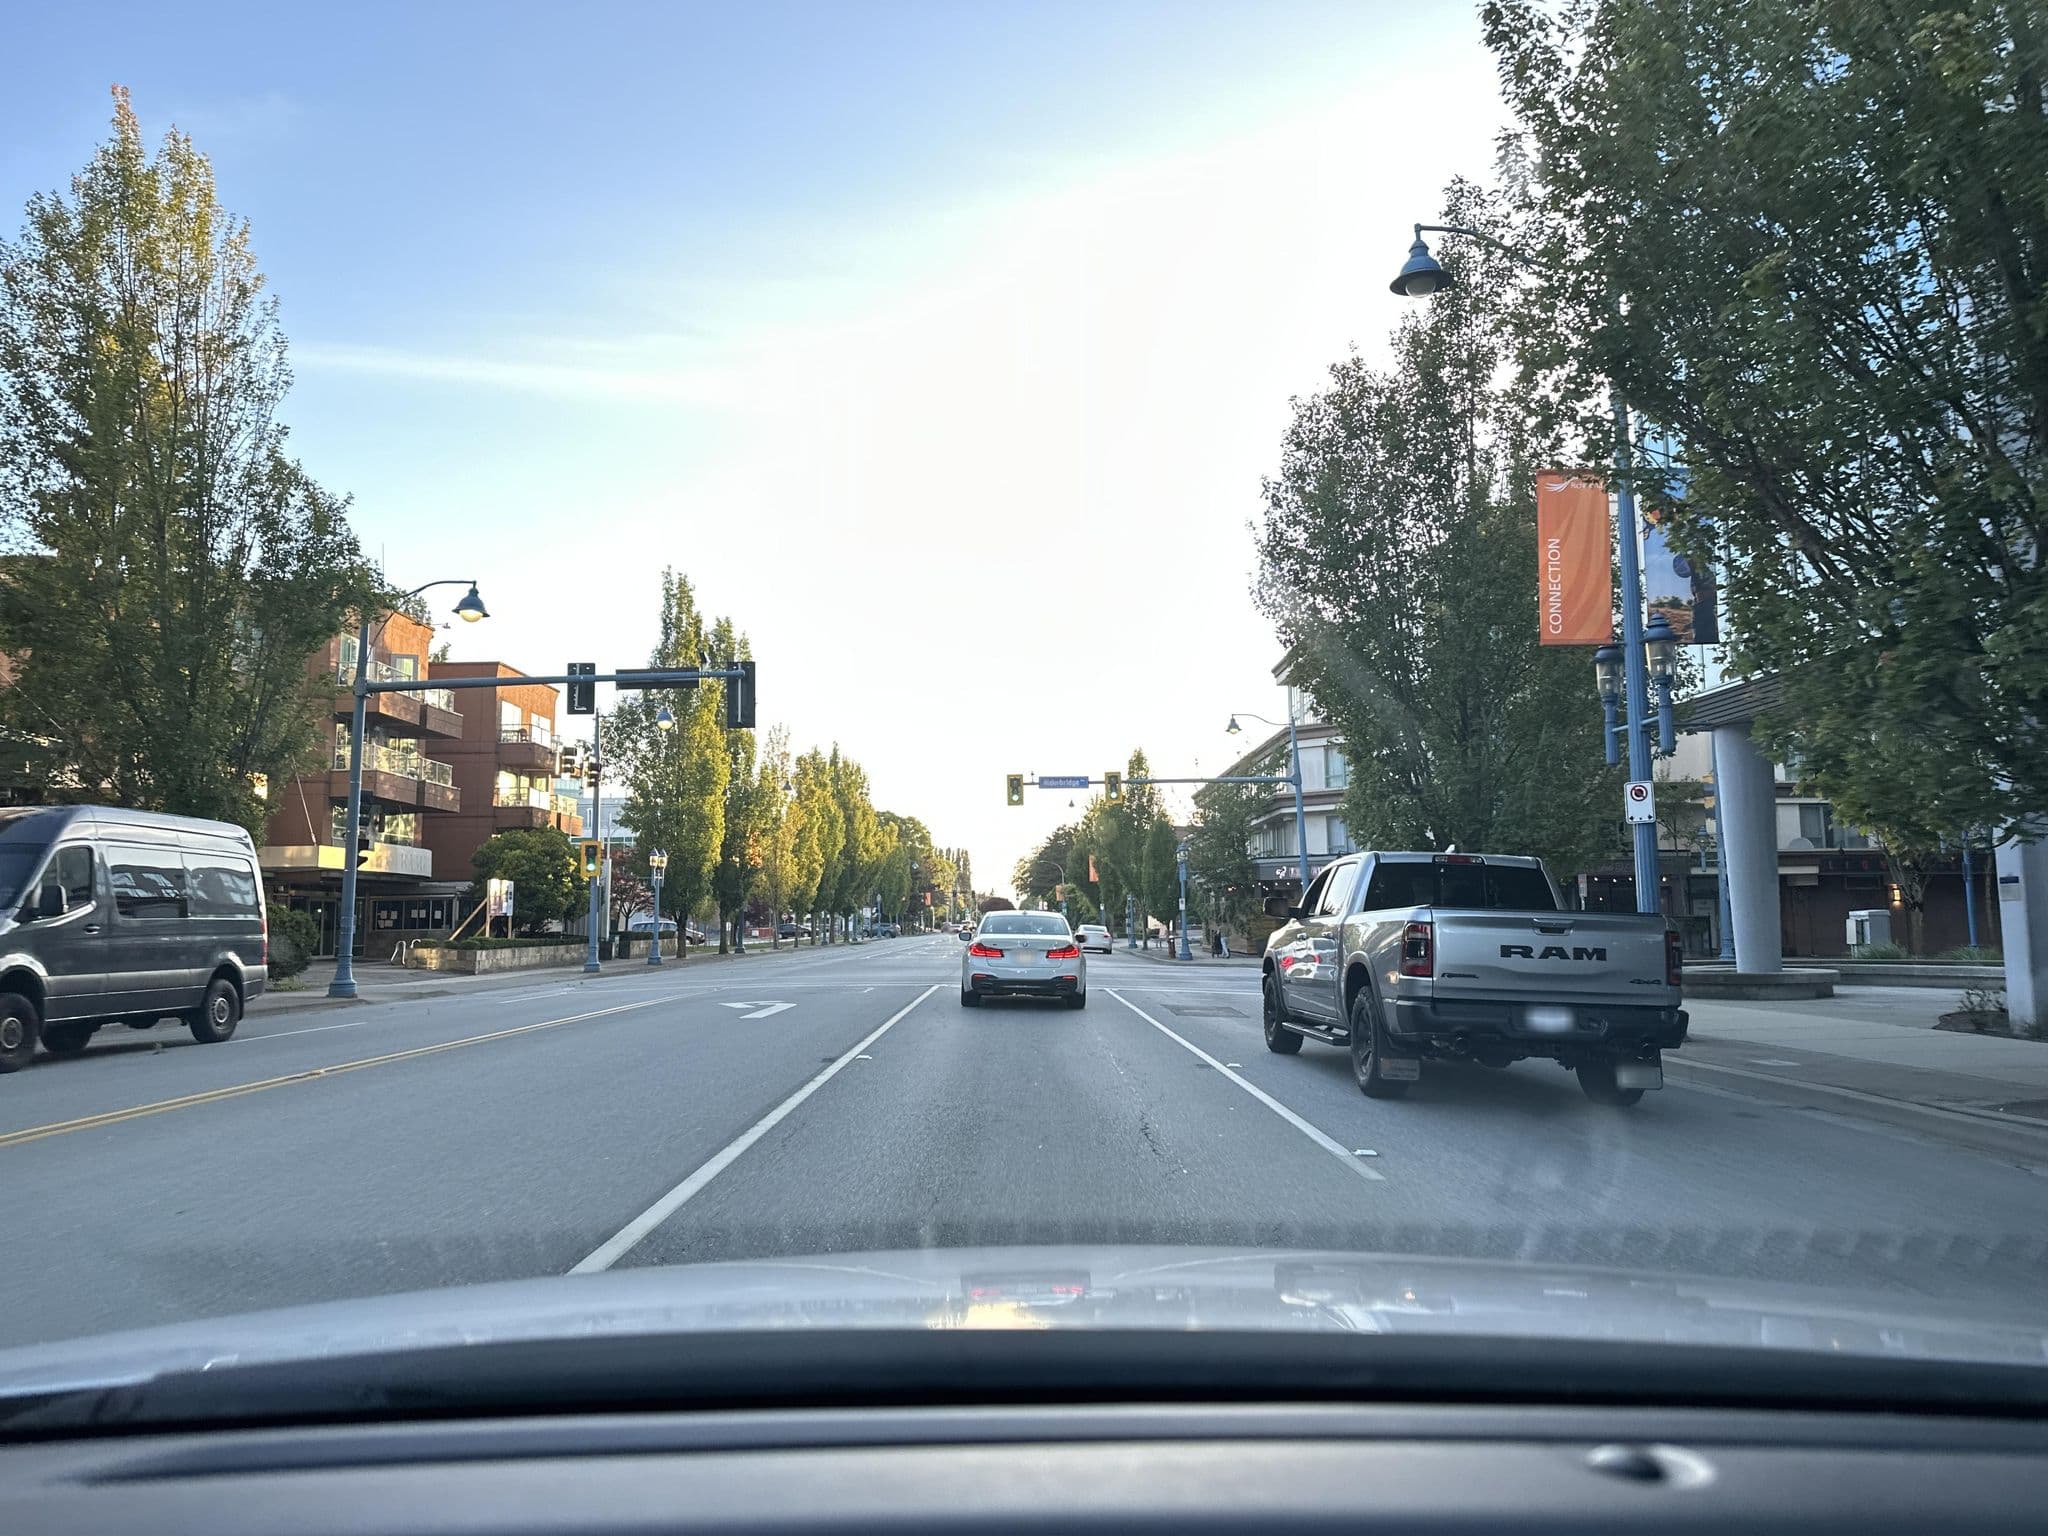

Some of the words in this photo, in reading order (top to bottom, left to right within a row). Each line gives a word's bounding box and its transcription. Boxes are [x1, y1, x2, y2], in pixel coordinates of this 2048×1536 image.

[1570, 481, 1603, 489] Richond
[1548, 538, 1563, 635] CONNECTION
[1500, 944, 1607, 962] RAM
[1629, 978, 1663, 986] 4x4
